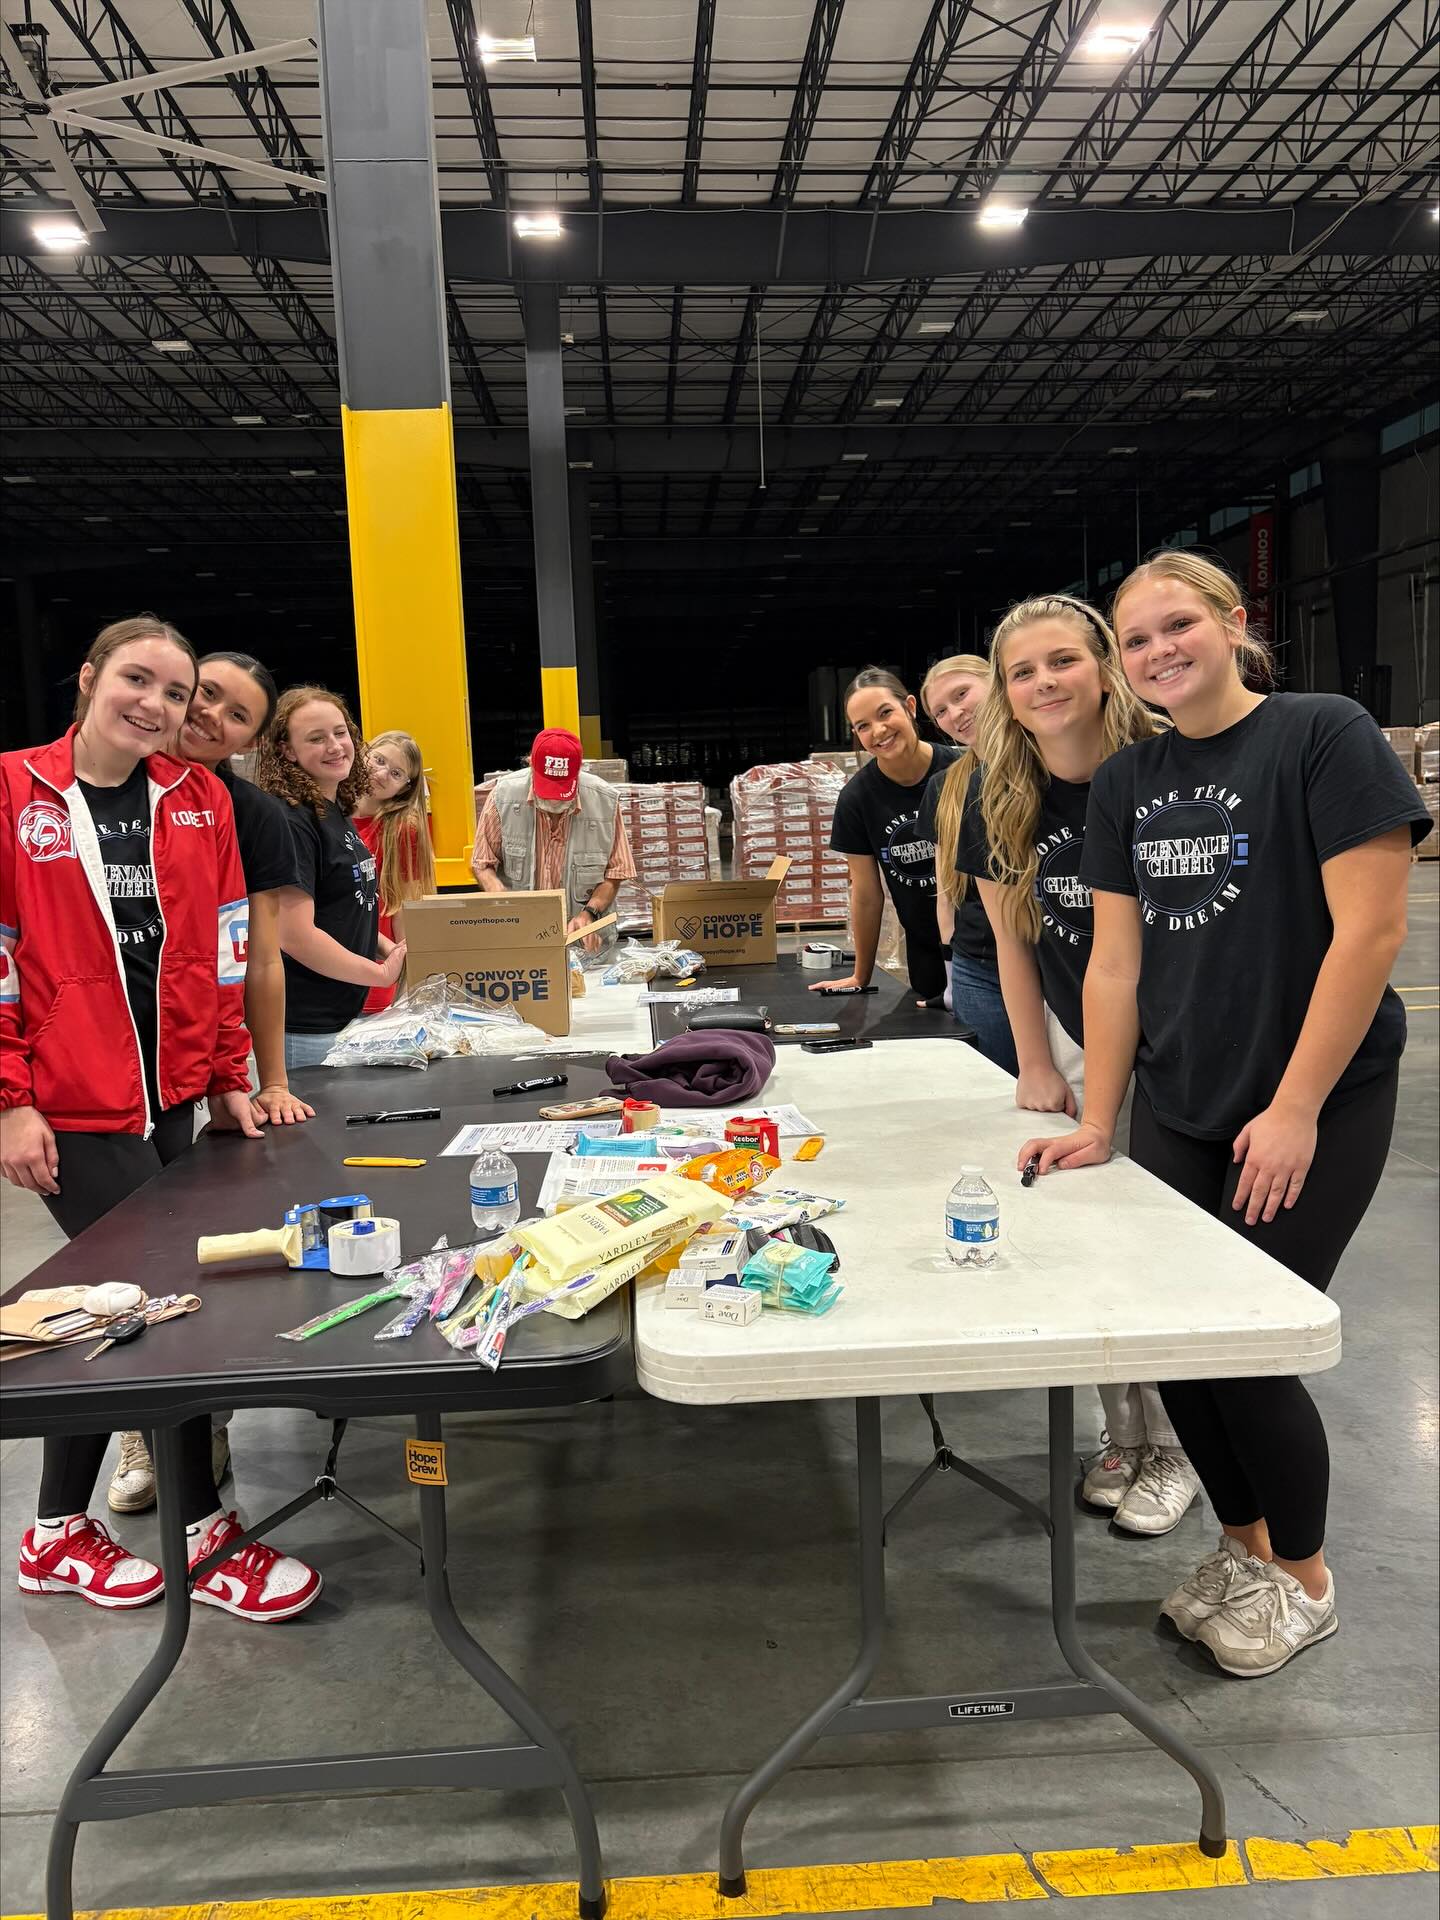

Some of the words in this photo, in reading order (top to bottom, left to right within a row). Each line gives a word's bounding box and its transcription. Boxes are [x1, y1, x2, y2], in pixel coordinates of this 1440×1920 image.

[1257, 528, 1268, 589] CONVOY
[545, 755, 569, 768] FBI
[1135, 790, 1179, 820] ONE
[1193, 784, 1243, 811] TEAM
[885, 813, 908, 834] ONE
[1036, 826, 1073, 855] ONE
[1137, 834, 1230, 861] GLENDALE
[901, 849, 936, 864] CHEE
[1146, 855, 1215, 877] CHEER
[890, 870, 912, 886] ONE
[1169, 883, 1242, 931] DREAM
[450, 916, 520, 926] convoyofhope.org
[703, 914, 746, 924] CONVOY
[749, 913, 763, 921] OF
[703, 922, 764, 939] HOPE
[1043, 915, 1079, 945] ONE
[465, 970, 525, 982] CONVOY
[529, 968, 548, 980] OF
[465, 980, 549, 1002] HOPE
[598, 1233, 648, 1262] YARDLEY
[603, 1261, 642, 1294] YARDLEY
[718, 1310, 739, 1321] Dove
[408, 1449, 438, 1465] Hope
[409, 1461, 438, 1475] Crew
[957, 1703, 1007, 1715] LIFETIME
